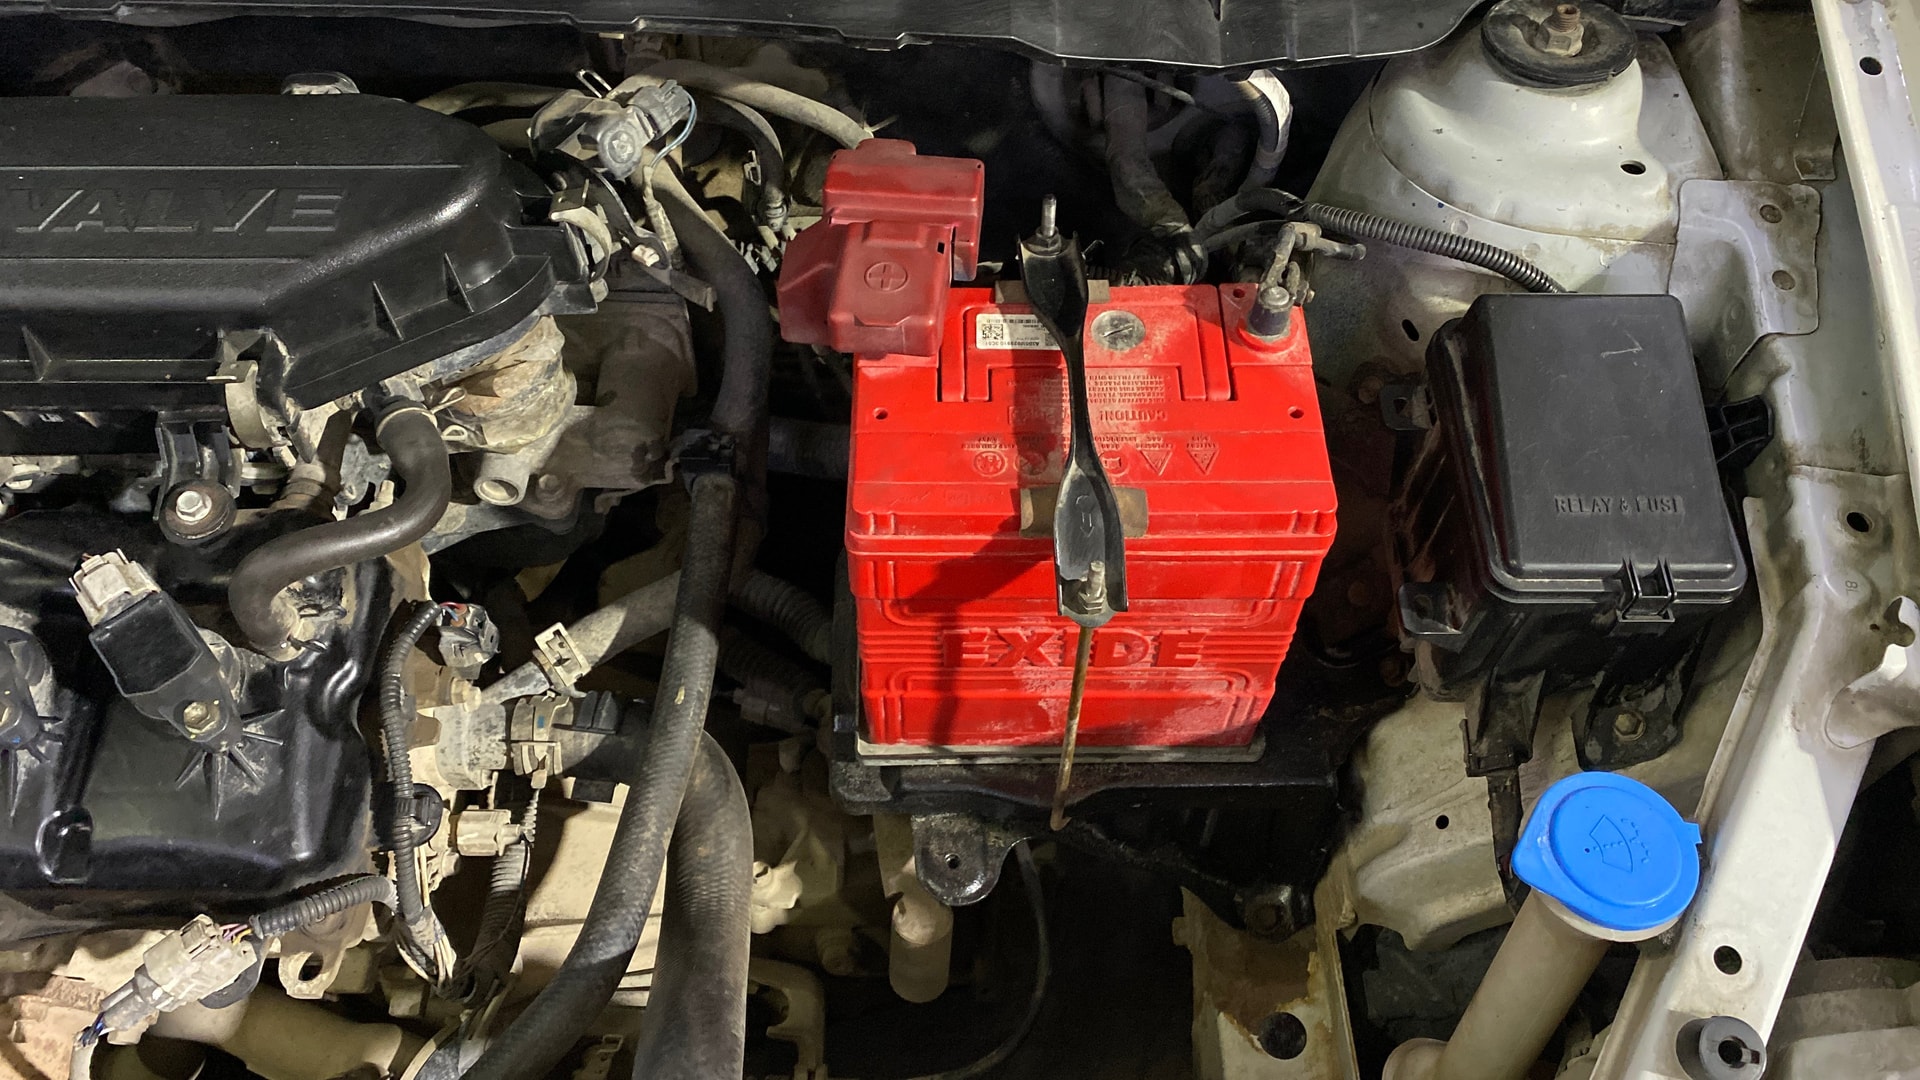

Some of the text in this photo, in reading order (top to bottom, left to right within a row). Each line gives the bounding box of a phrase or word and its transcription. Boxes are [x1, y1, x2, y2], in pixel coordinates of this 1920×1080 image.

[8, 187, 345, 232] VALVE
[1099, 410, 1166, 422] CAUTION!
[1554, 496, 1613, 514] RELAY
[1619, 497, 1630, 514] &
[941, 627, 1211, 668] EXIDE
